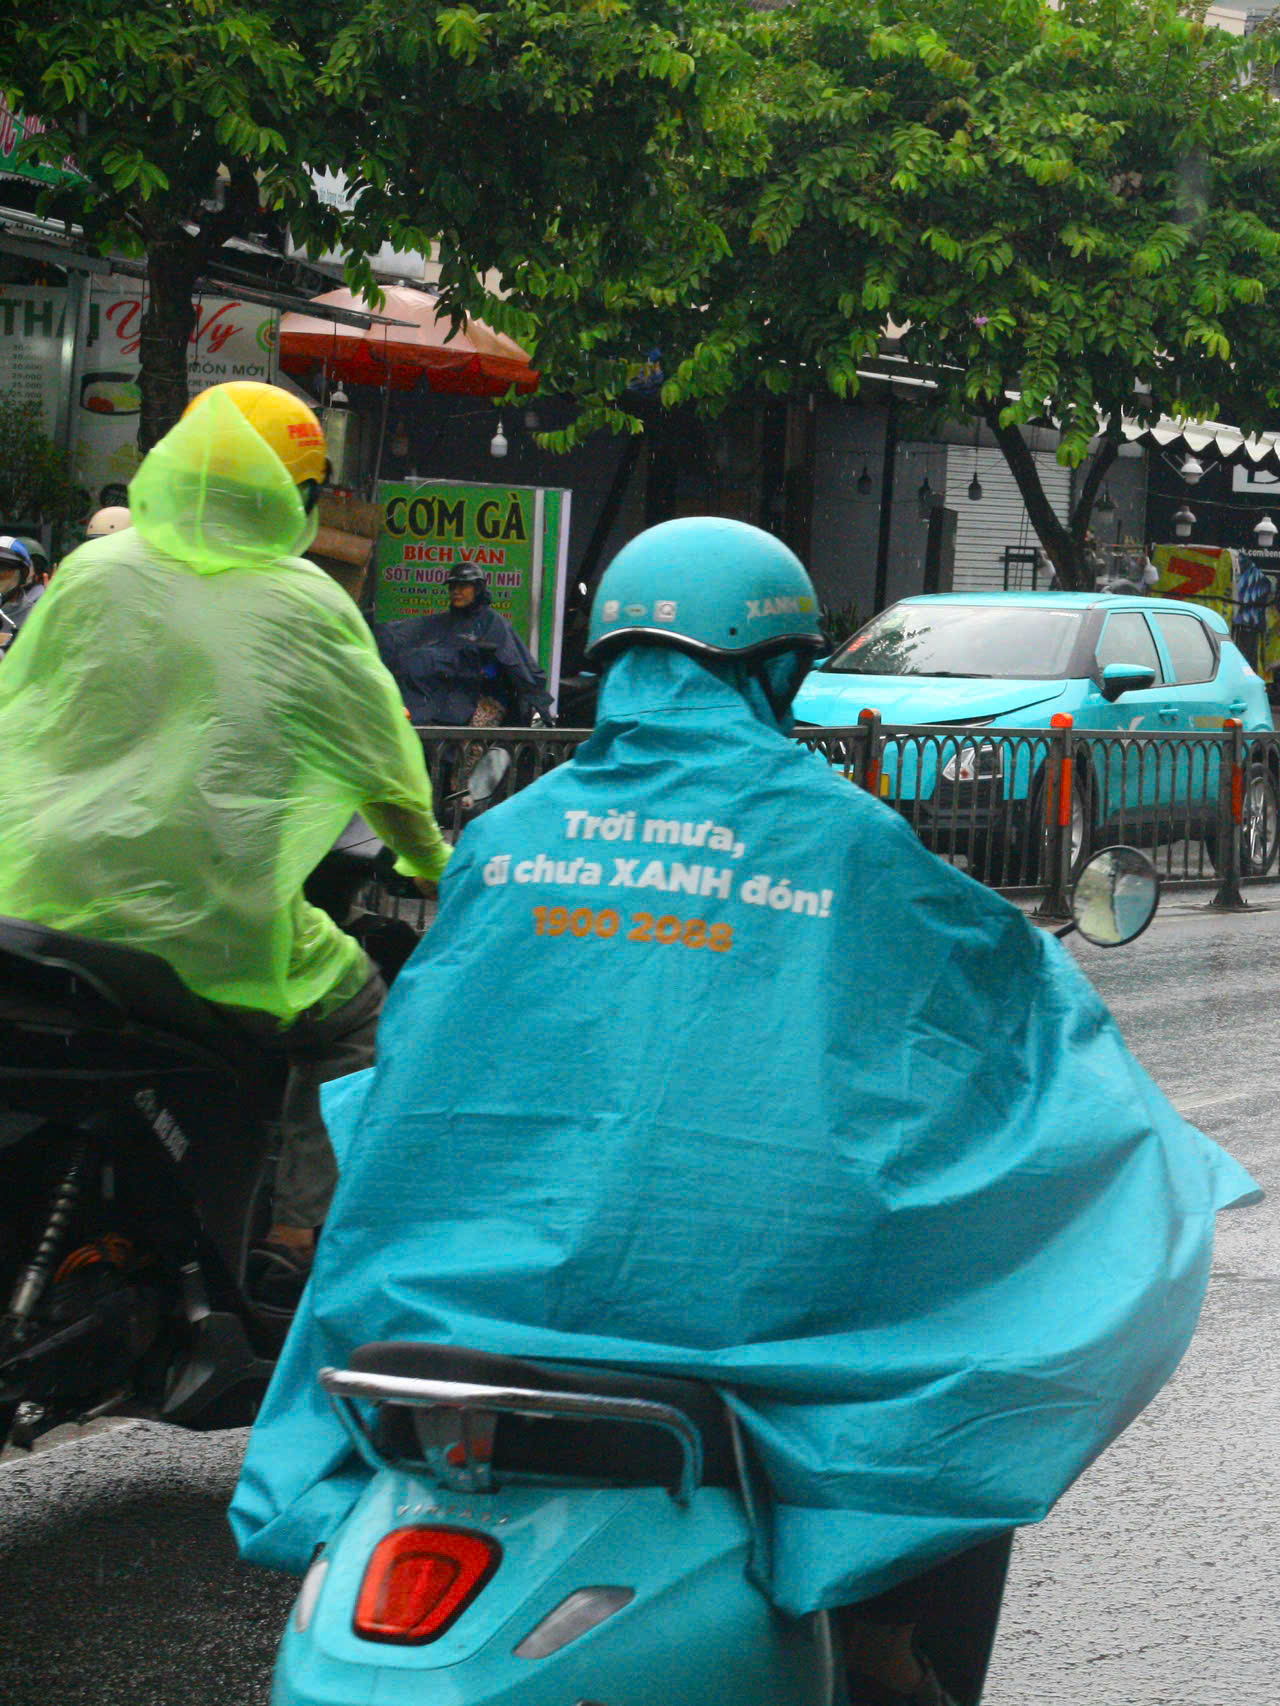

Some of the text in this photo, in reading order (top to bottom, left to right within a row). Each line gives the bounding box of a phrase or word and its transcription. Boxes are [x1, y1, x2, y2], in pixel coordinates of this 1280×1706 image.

[386, 493, 527, 541] CƠM GÀ
[404, 543, 453, 562] BÍCH
[564, 808, 747, 858] Trời mưa,
[482, 854, 834, 918] đi chưa XANH đón!
[532, 905, 735, 952] 1900 2088
